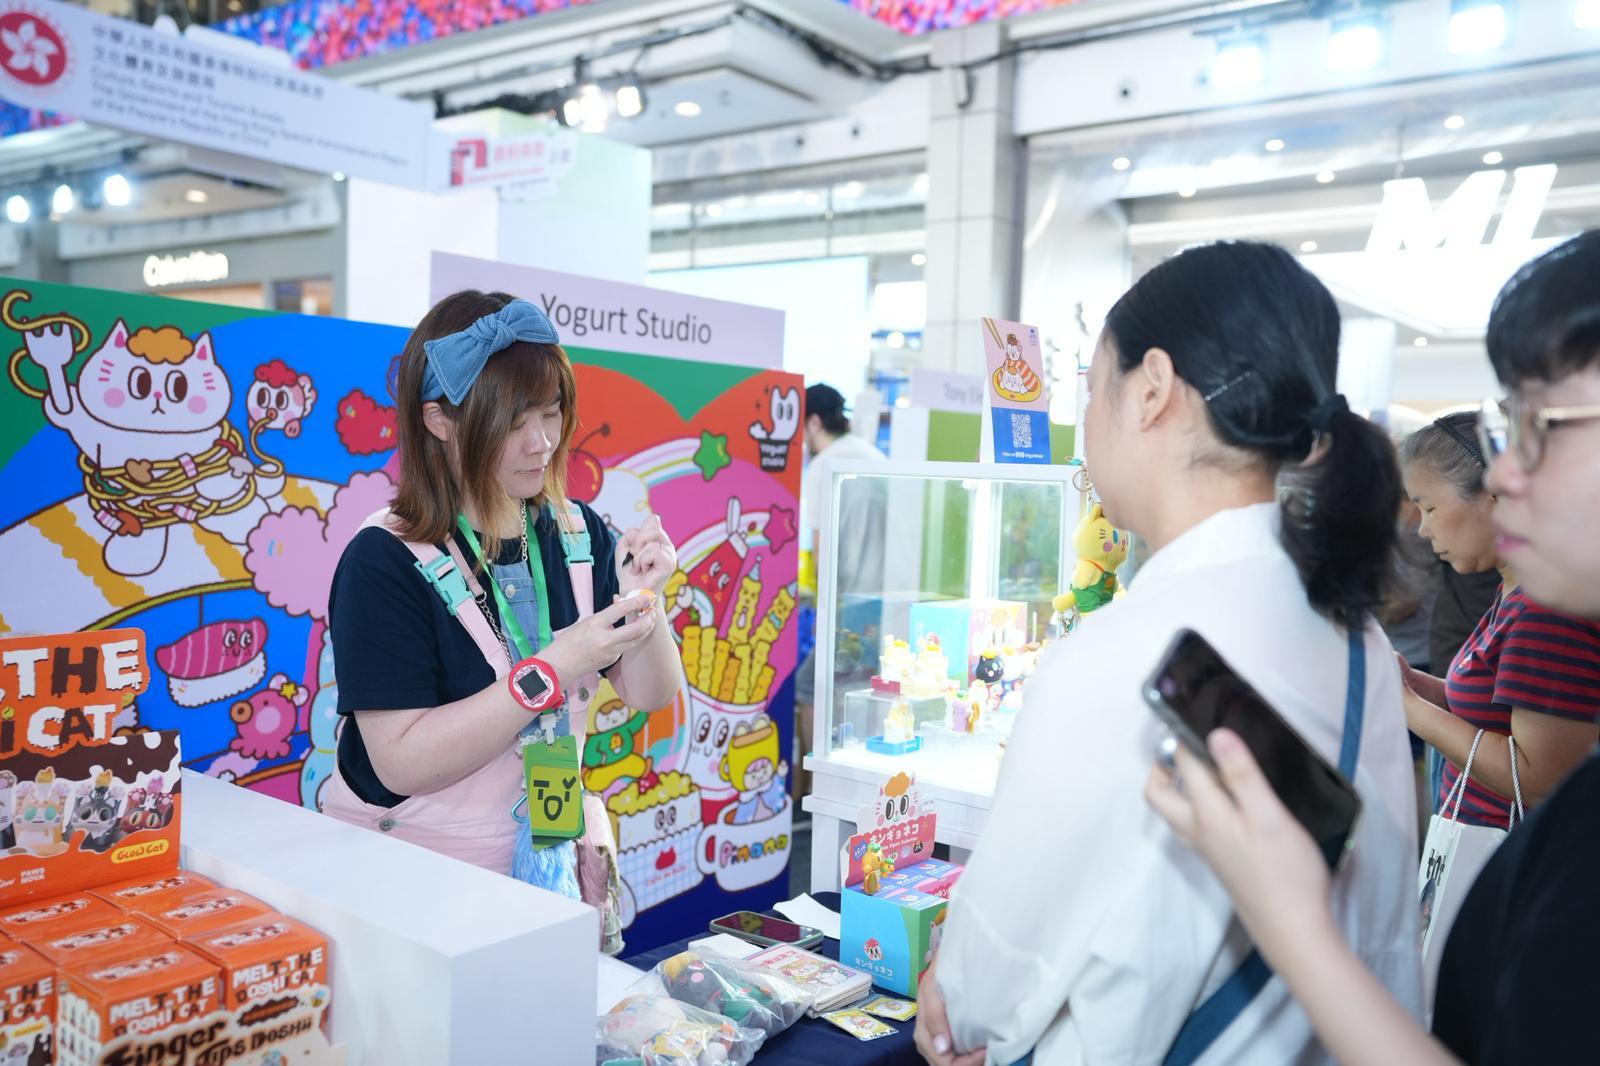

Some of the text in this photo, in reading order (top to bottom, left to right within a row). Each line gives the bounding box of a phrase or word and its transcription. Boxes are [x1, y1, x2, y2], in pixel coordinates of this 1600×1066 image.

[540, 293, 712, 345] Yogurt Studio
[27, 704, 116, 751] CAT
[290, 967, 317, 985] CAT
[178, 999, 209, 1018] CAT
